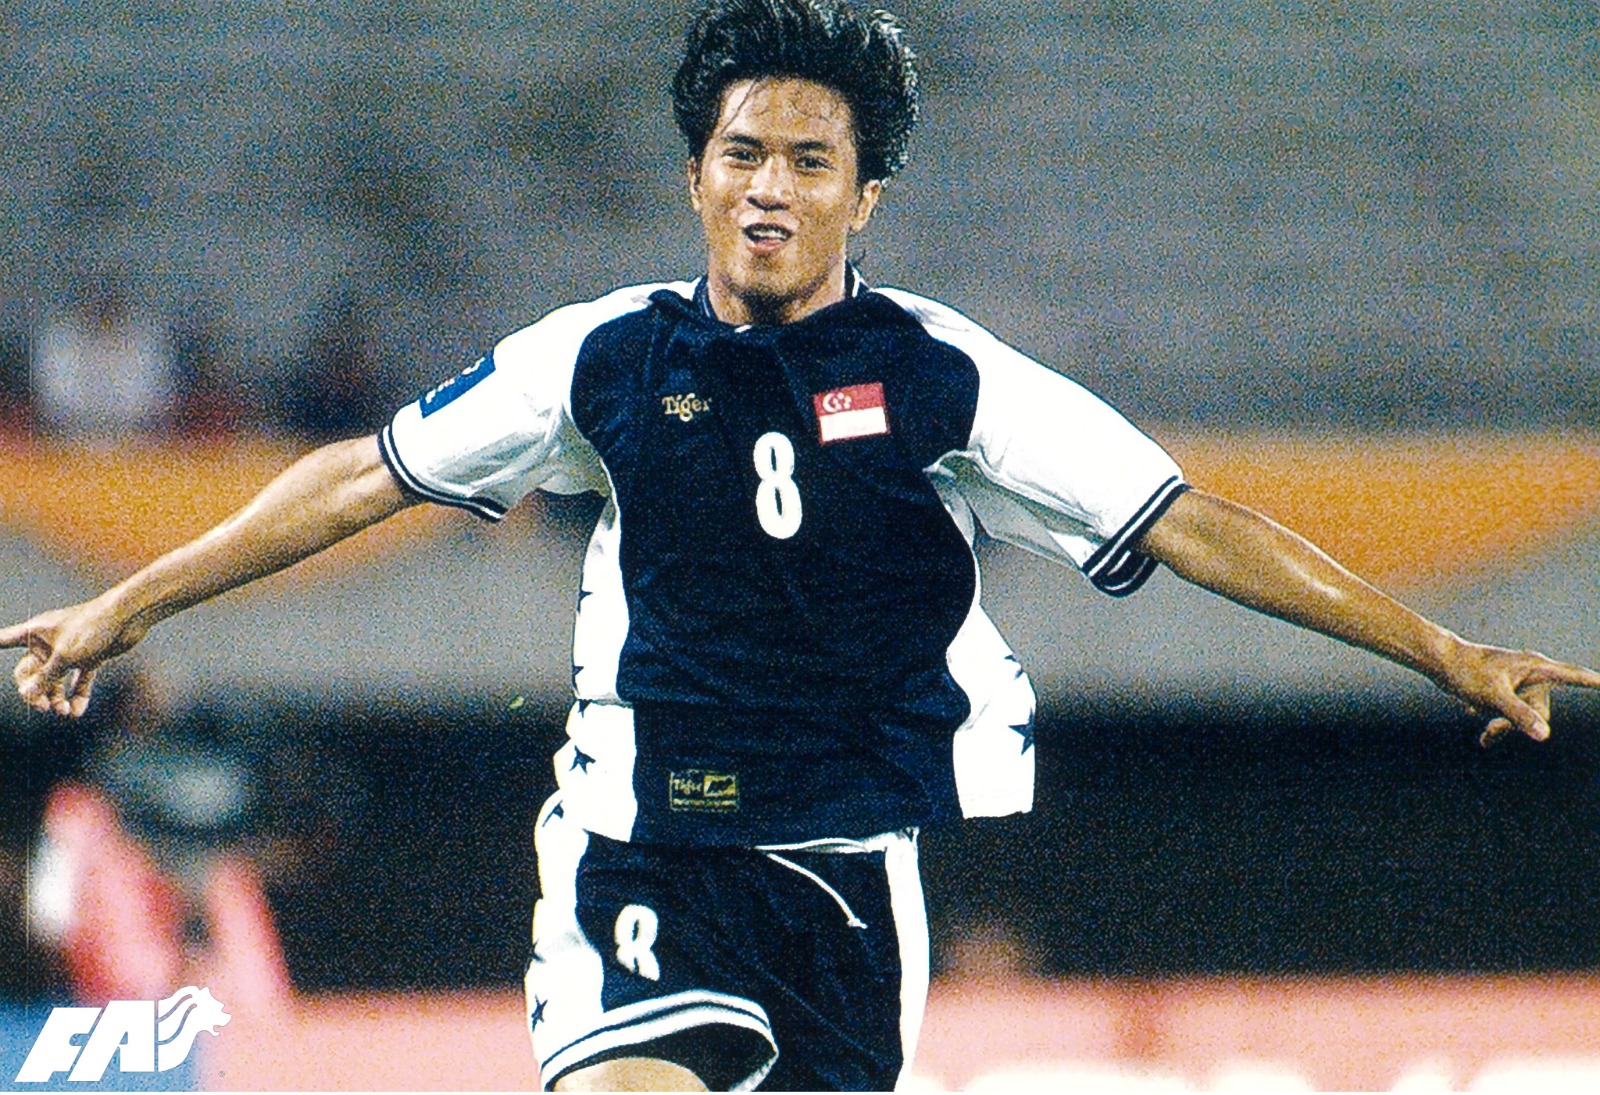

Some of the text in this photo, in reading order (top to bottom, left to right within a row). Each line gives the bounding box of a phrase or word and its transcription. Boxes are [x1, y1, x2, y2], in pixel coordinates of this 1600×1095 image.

[662, 393, 712, 421] Tiger
[753, 431, 803, 540] 8
[614, 904, 660, 981] 8
